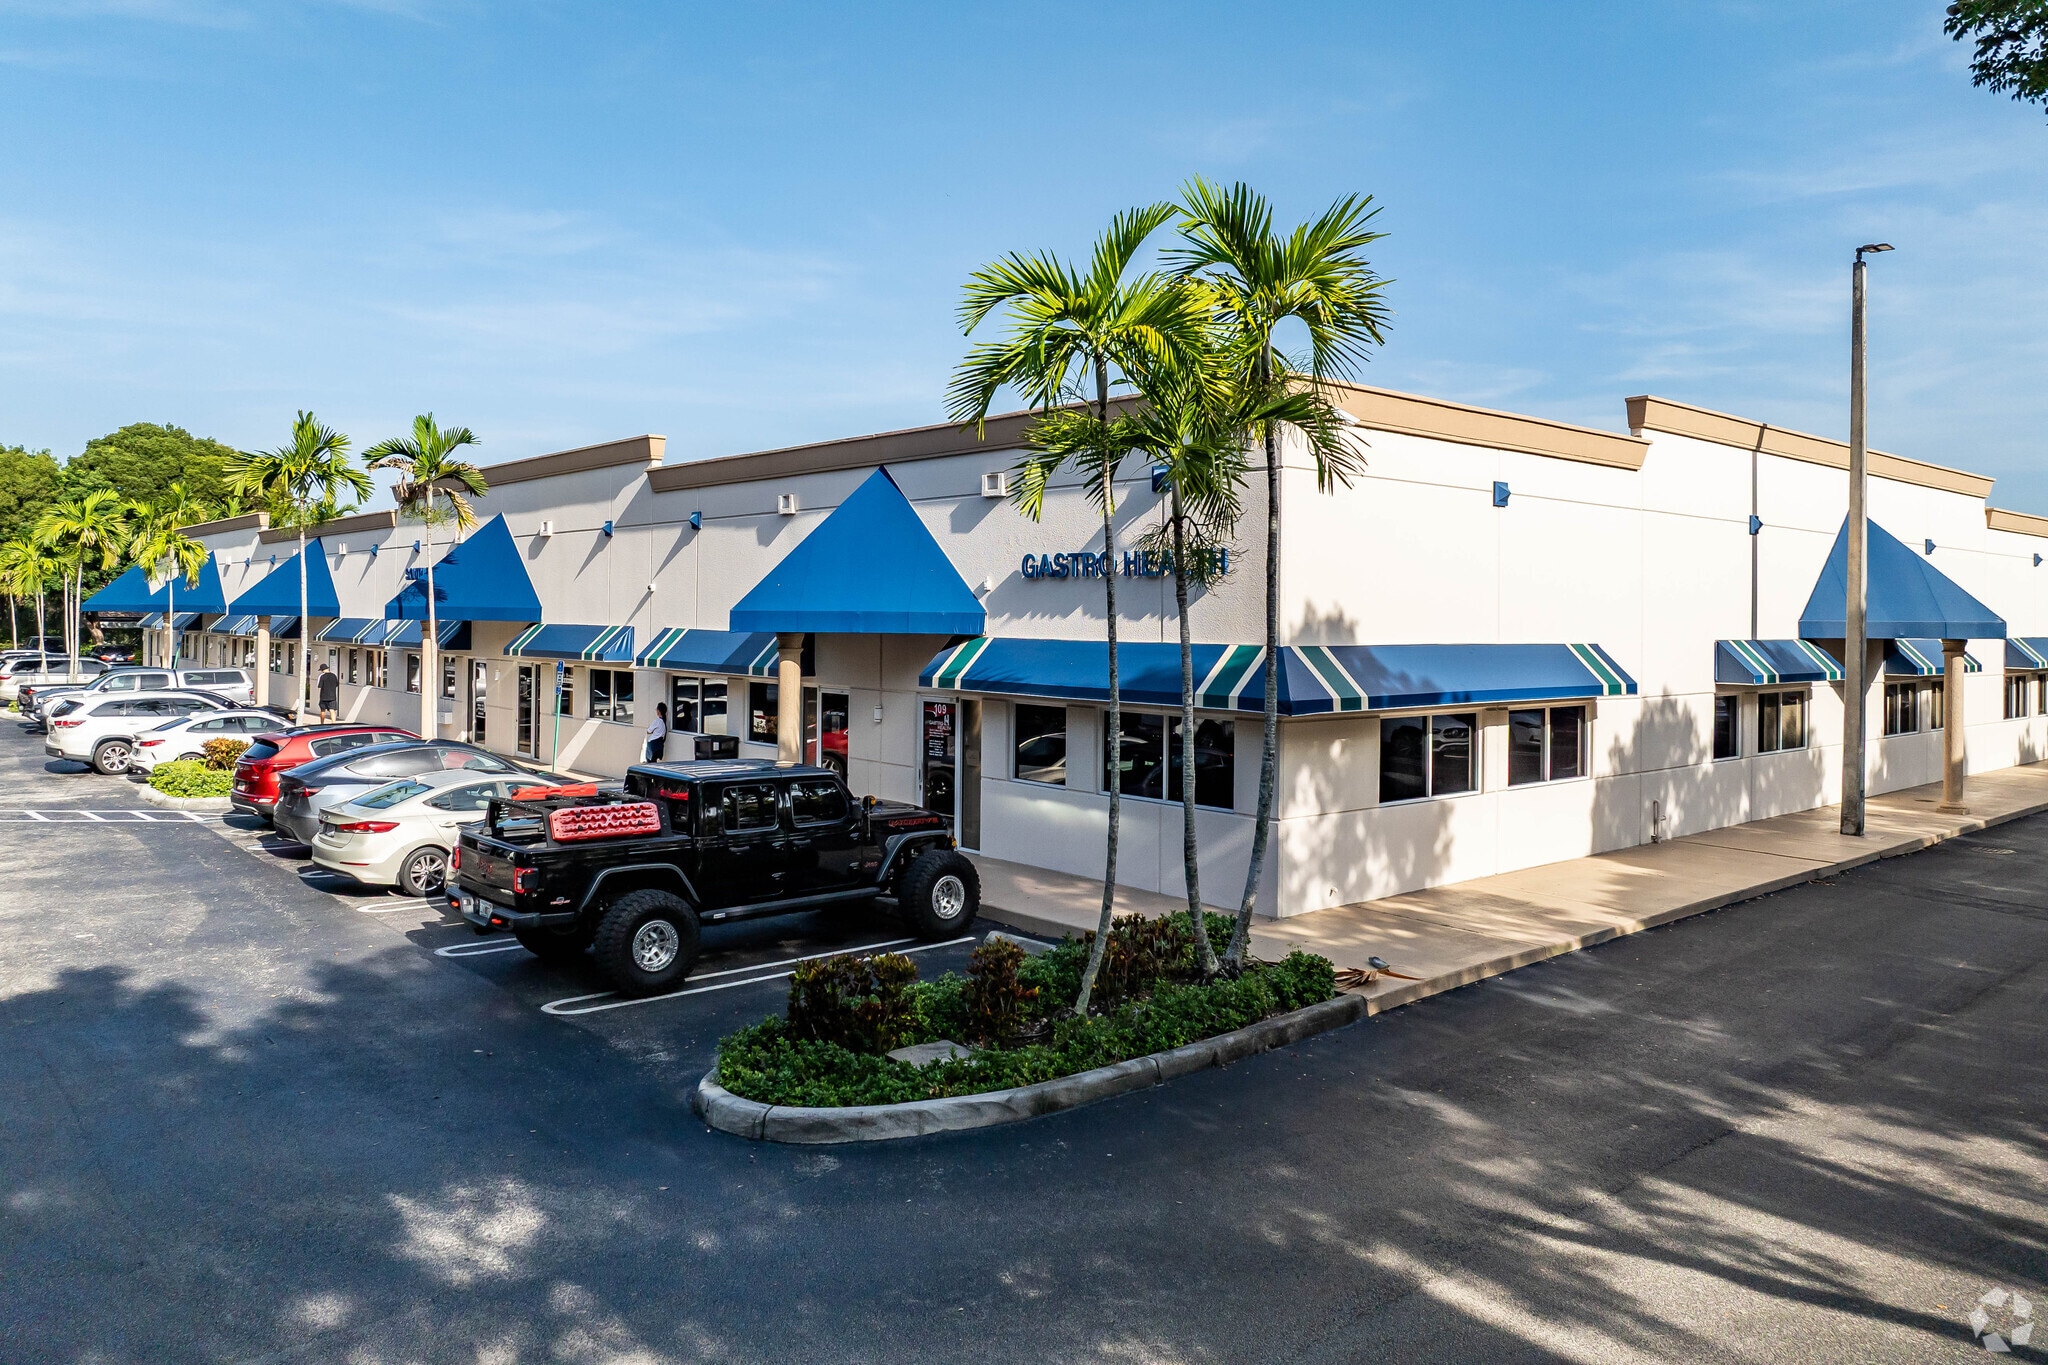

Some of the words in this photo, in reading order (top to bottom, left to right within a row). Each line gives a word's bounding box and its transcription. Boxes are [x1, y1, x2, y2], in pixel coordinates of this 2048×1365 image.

[1022, 551, 1117, 579] GASTRO
[1123, 548, 1228, 577] HEAH
[934, 704, 946, 714] 109
